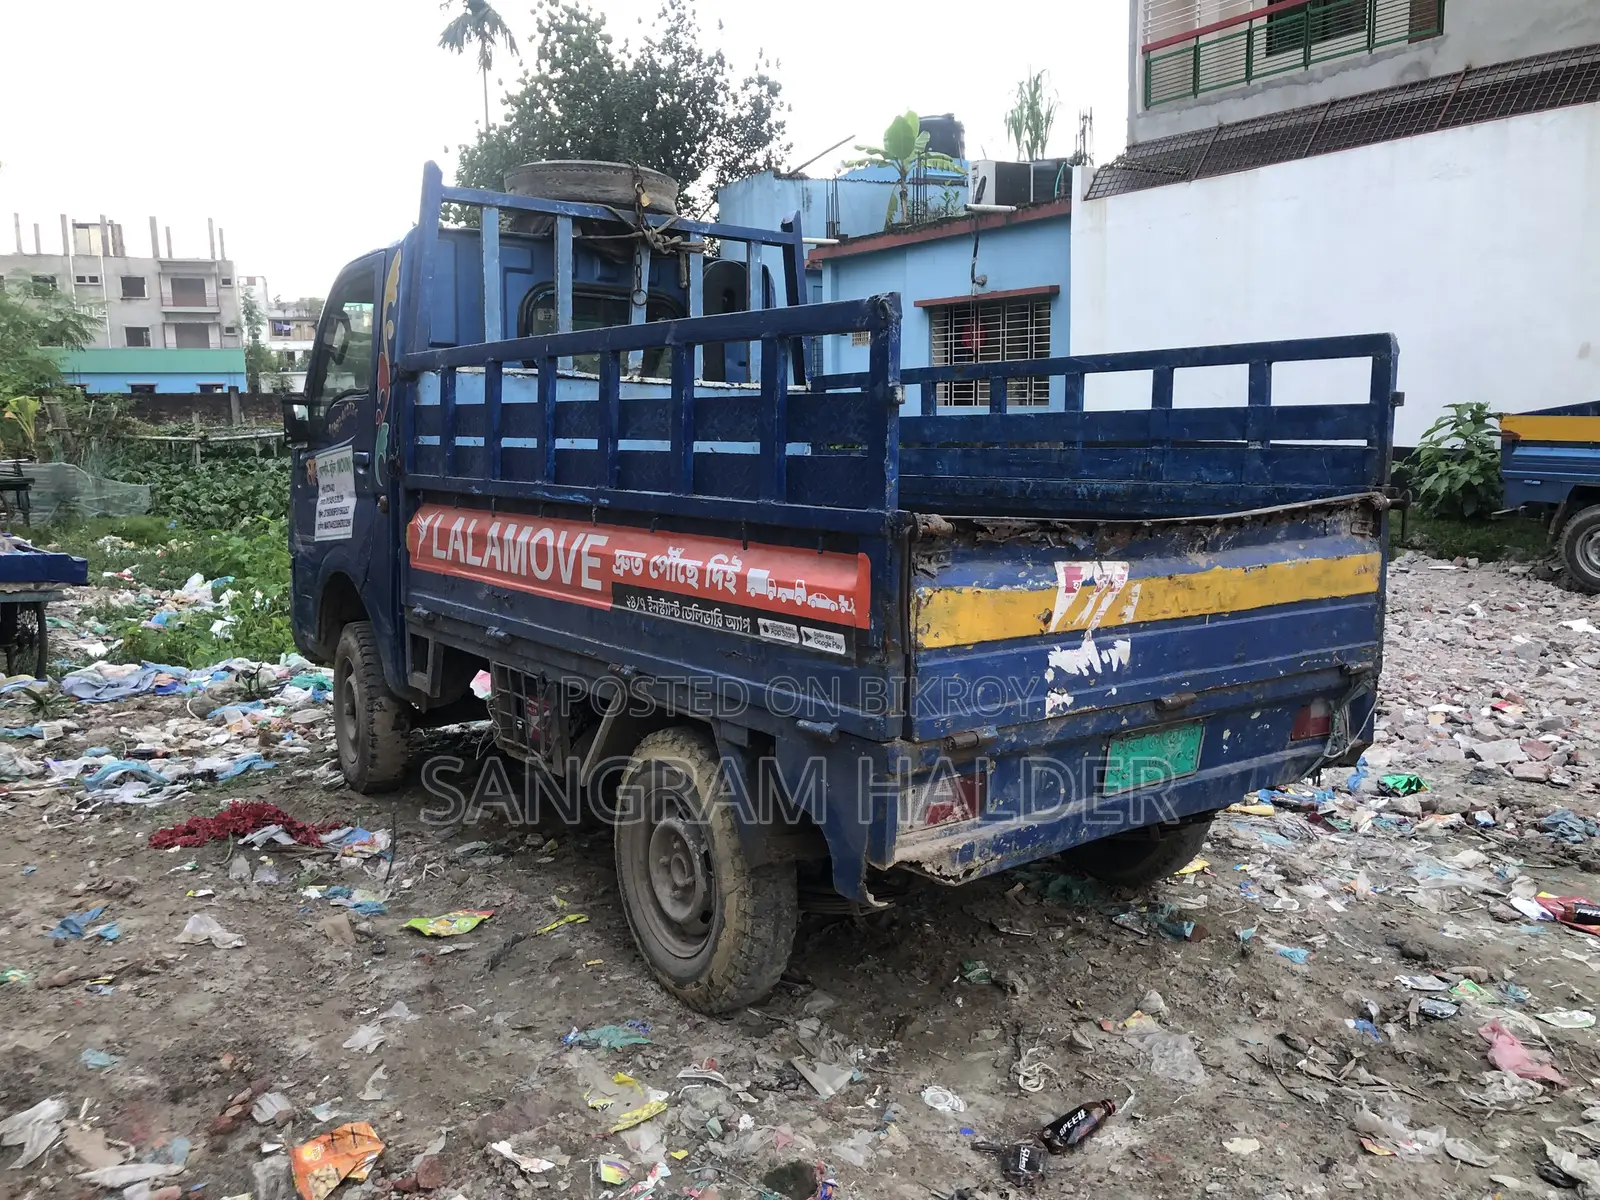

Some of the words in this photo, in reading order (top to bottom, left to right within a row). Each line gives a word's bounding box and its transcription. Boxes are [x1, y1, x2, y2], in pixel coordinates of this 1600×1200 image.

[432, 515, 609, 591] LALAMOVE
[612, 549, 647, 578] দ্রুত
[648, 546, 703, 590] পৌঁছে
[705, 553, 743, 595] দিই
[626, 595, 647, 613] ২৪/৭
[681, 604, 724, 628] ডেলিভারি
[814, 638, 831, 649] Google
[831, 641, 843, 652] Play
